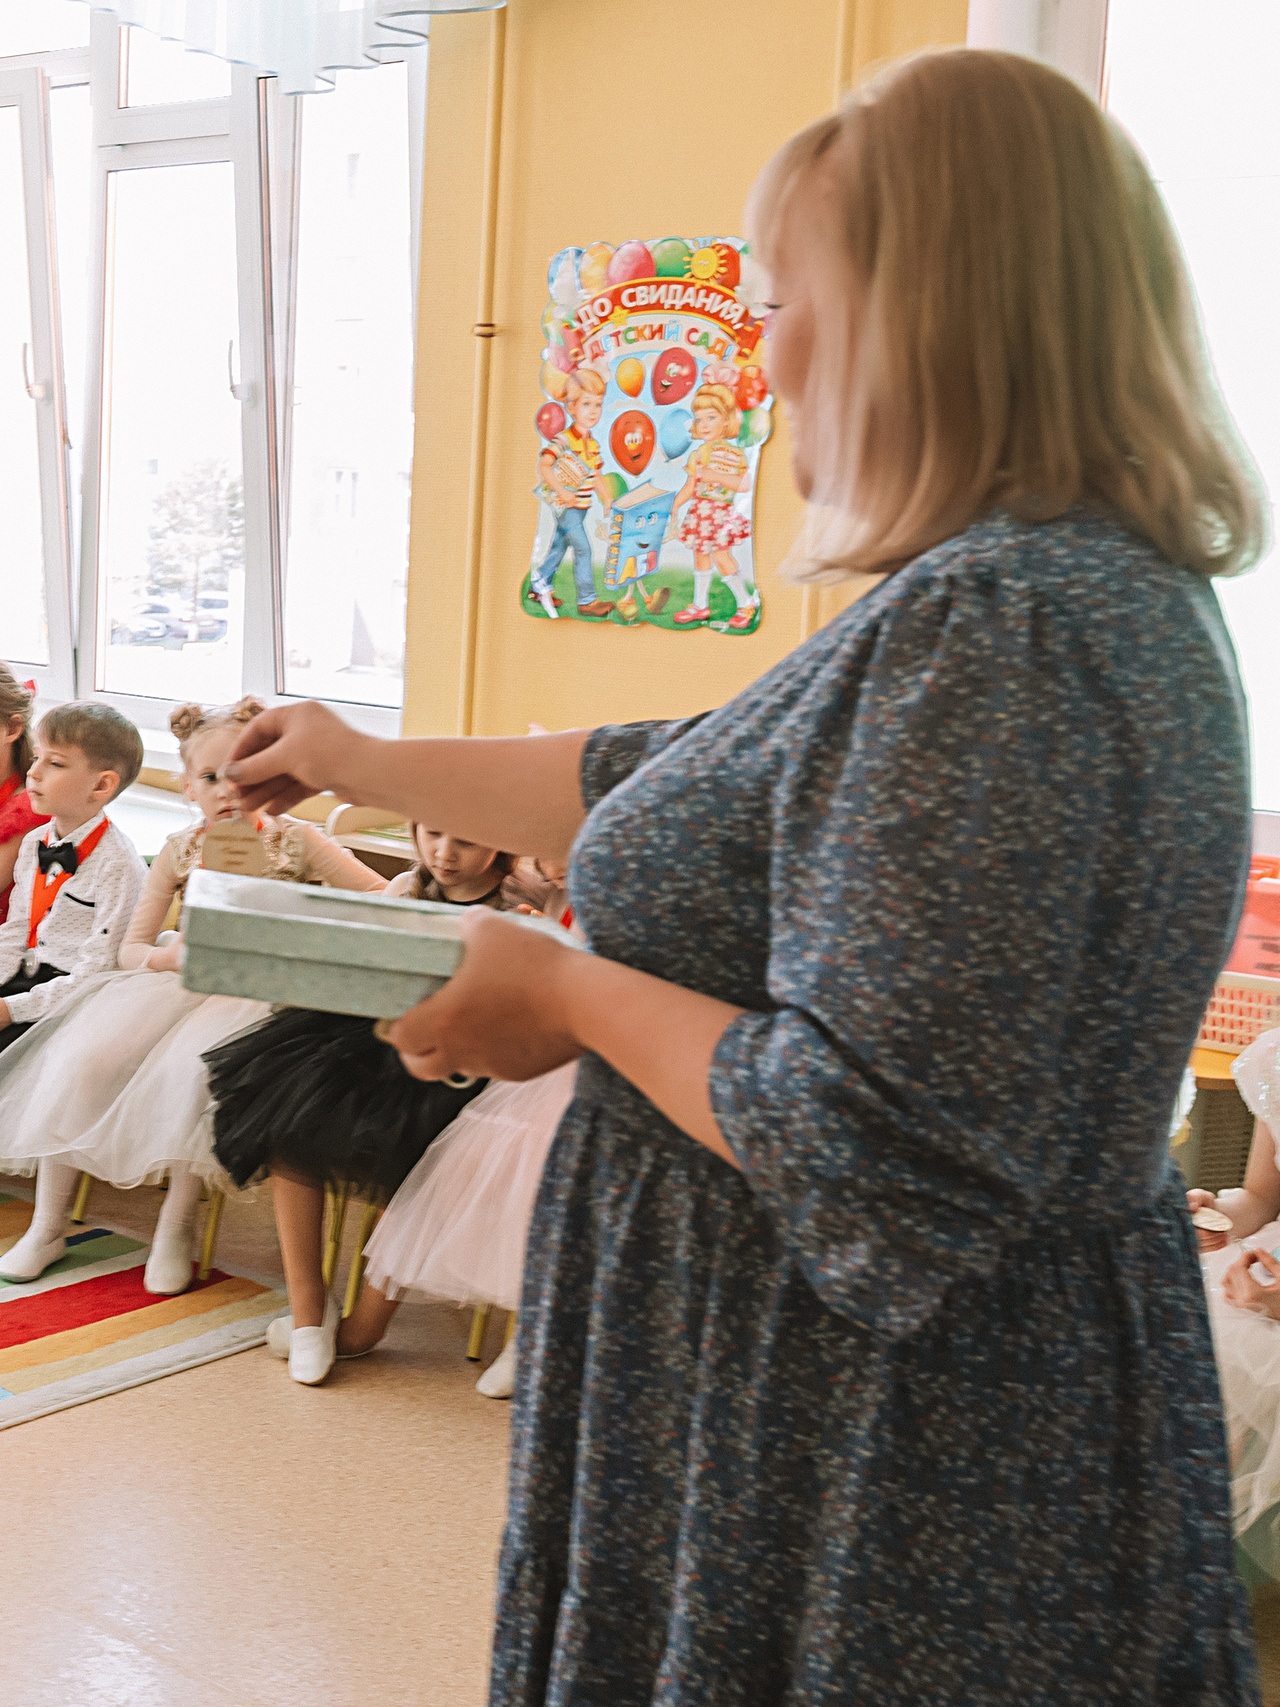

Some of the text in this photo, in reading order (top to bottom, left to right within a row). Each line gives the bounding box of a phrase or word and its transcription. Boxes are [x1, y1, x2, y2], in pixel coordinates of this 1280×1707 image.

[576, 284, 746, 330] ДО СВИДАНИЯ,
[589, 320, 735, 363] ДЕТСКИЙ САД!
